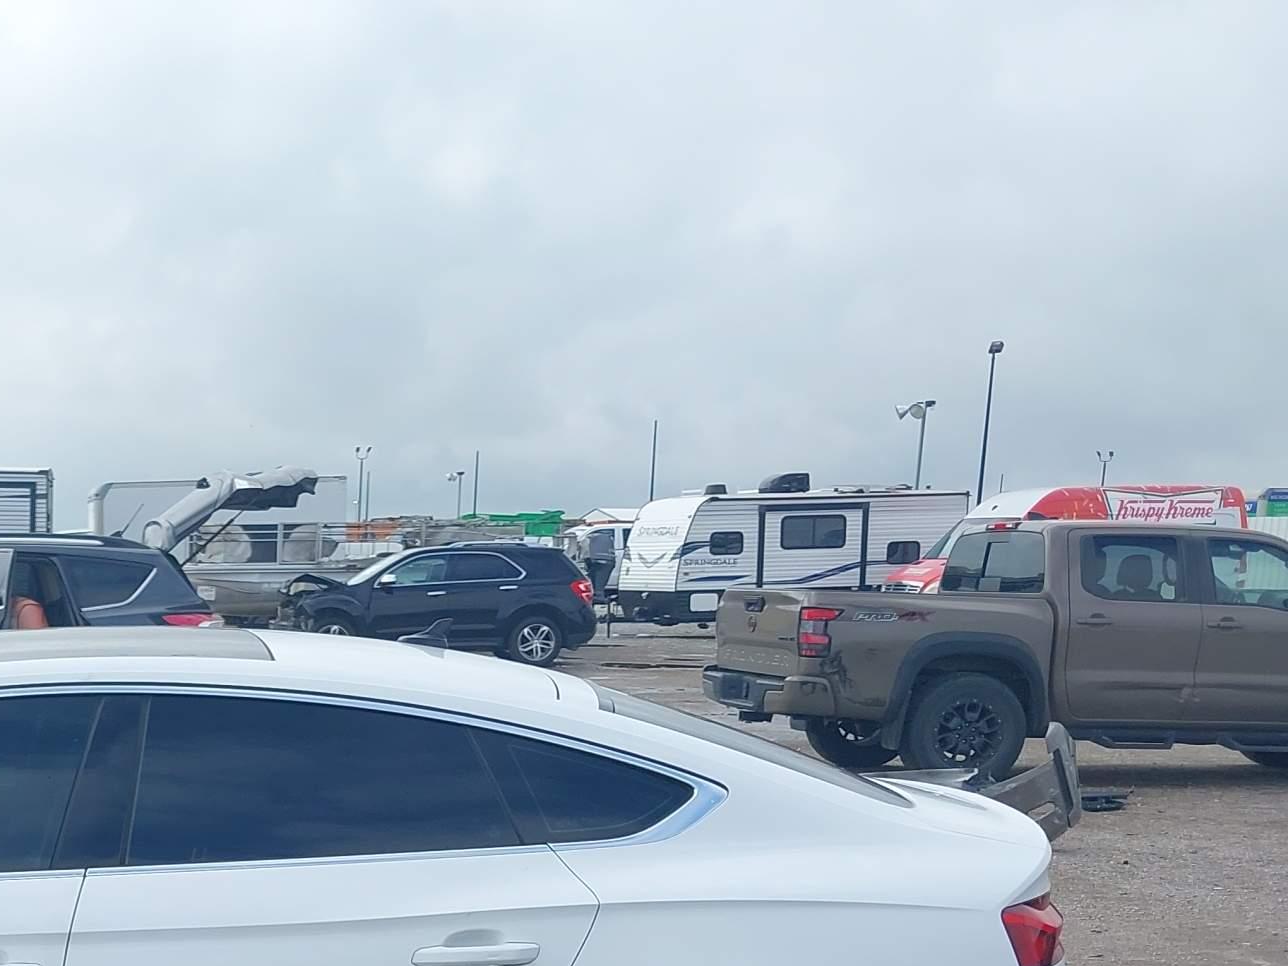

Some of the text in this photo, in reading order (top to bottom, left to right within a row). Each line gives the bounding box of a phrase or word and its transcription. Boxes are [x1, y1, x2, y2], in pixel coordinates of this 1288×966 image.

[1115, 499, 1215, 522] Krispy Kreme
[682, 558, 739, 567] SPRINGDALE
